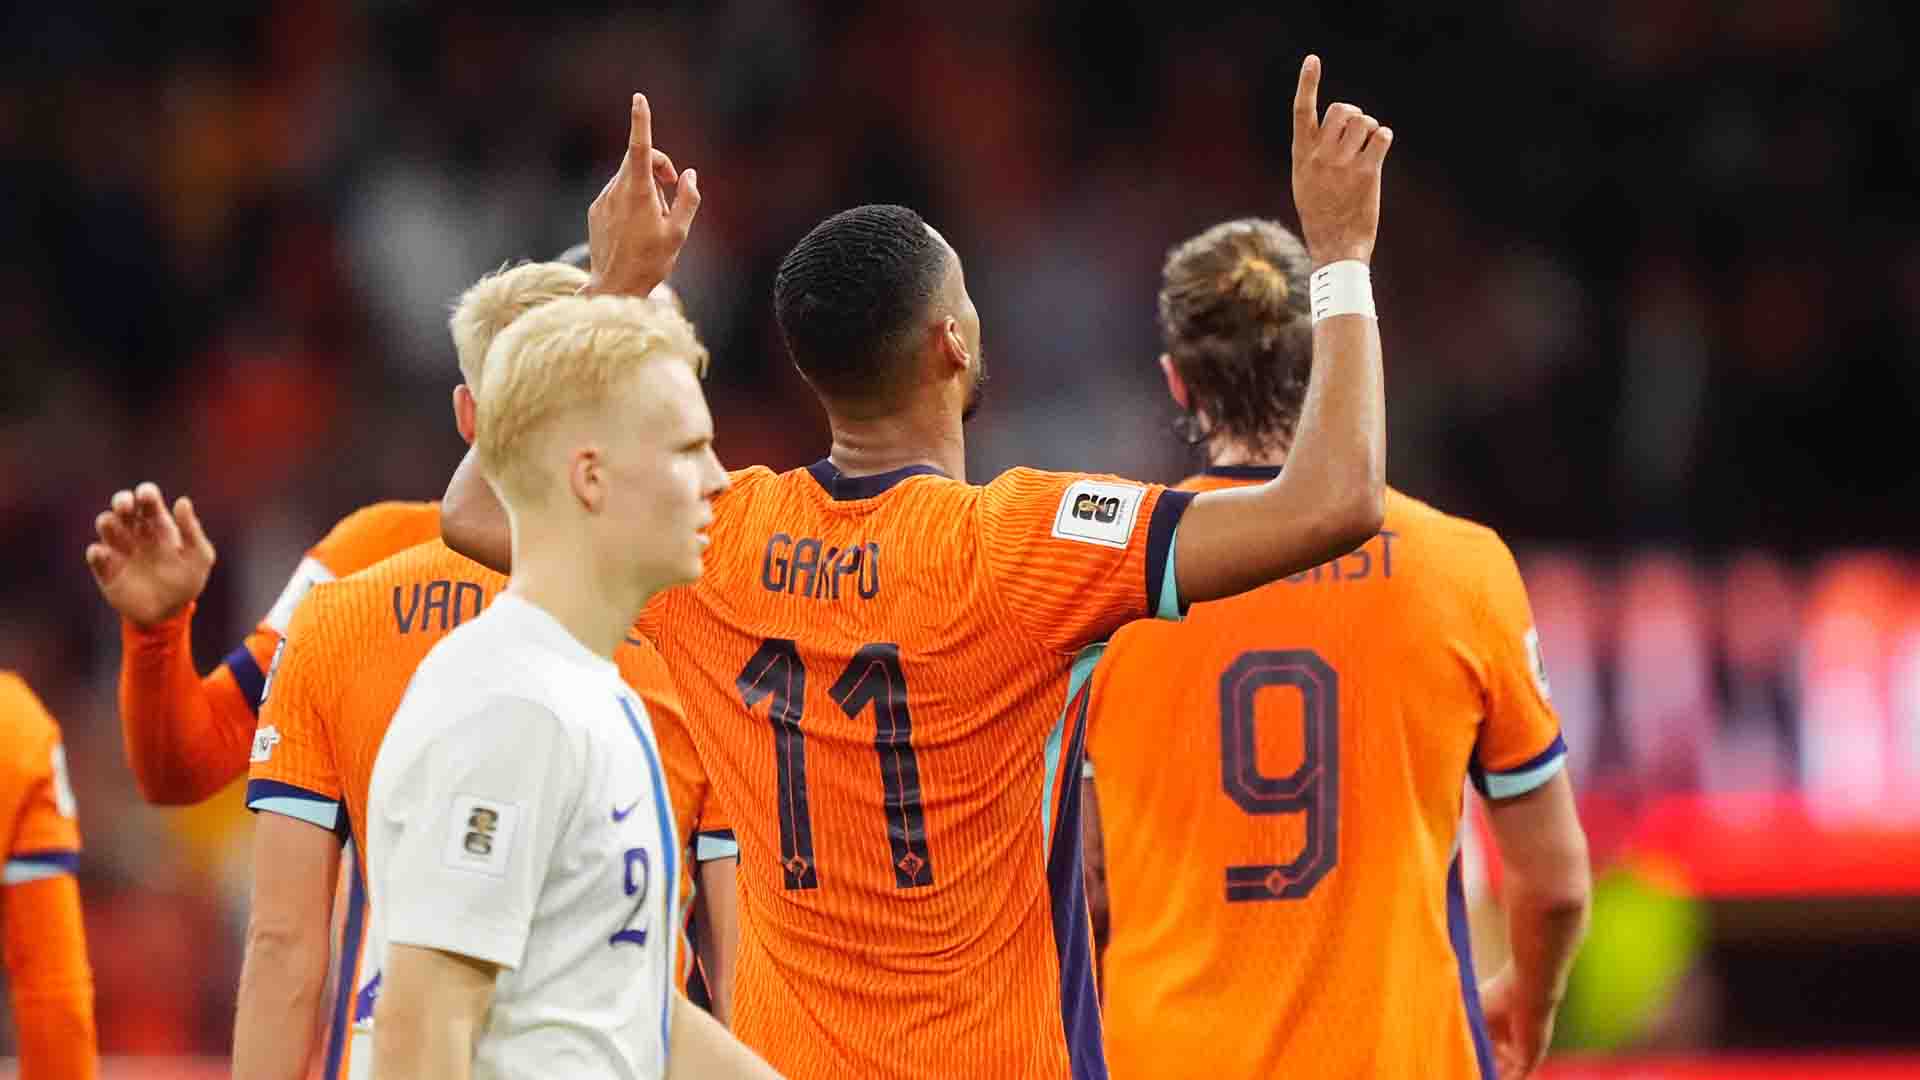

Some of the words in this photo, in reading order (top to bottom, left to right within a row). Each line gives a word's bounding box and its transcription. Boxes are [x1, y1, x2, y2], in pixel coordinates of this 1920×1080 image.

[762, 532, 880, 600] GAKPO
[736, 638, 935, 890] 11
[1220, 649, 1339, 902] 9
[609, 848, 649, 948] 2
